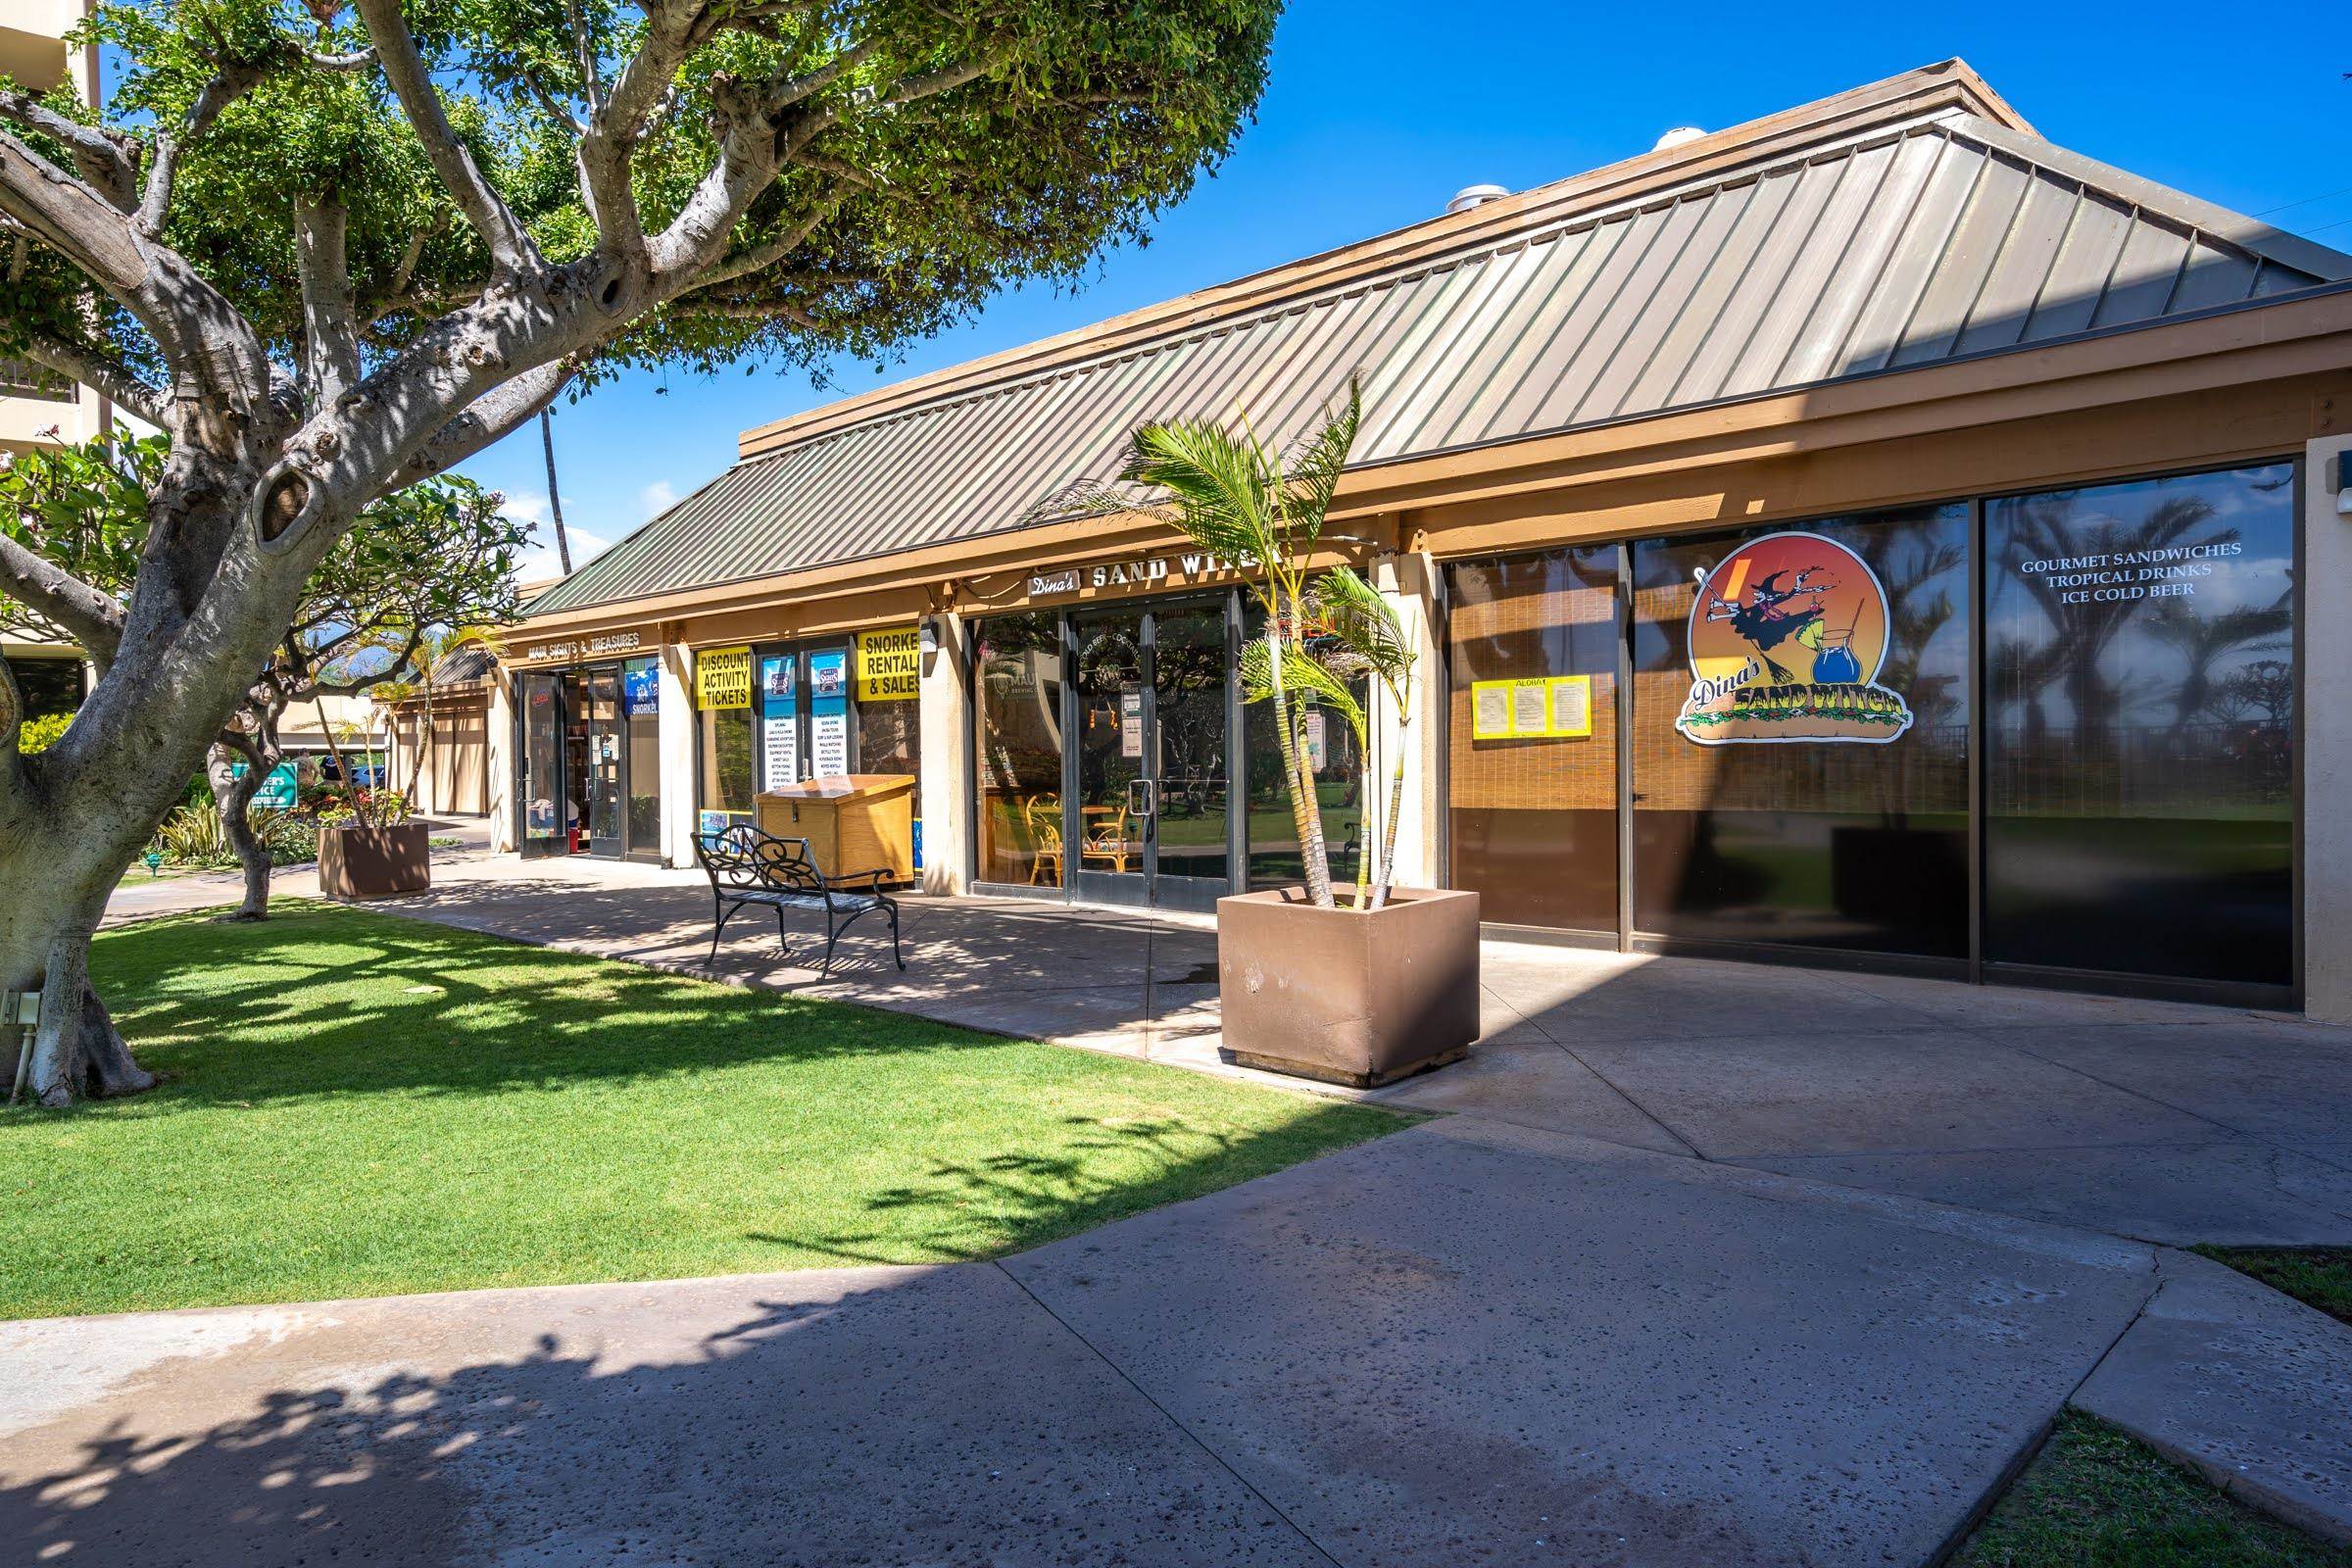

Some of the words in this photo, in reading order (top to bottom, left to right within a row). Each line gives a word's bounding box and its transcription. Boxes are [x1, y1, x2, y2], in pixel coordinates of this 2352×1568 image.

[2021, 555, 2110, 573] GOURMET
[2113, 542, 2242, 565] SANDWICHES
[1031, 572, 1073, 594] Dina's
[1093, 560, 1167, 587] SAND
[2046, 571, 2134, 588] TROPICAL
[2138, 564, 2212, 581] DRINKS
[2061, 591, 2089, 605] ICE
[2093, 587, 2145, 603] COLD
[2149, 583, 2195, 598] BEER
[549, 641, 578, 656] SIGHTS
[579, 640, 587, 653] &
[591, 632, 640, 651] TREASURES
[865, 632, 918, 655] SNORKE
[1079, 644, 1094, 664] COLD
[1092, 634, 1108, 646] BEER
[702, 652, 750, 671] DISCOUNT
[705, 670, 748, 688] ACTIVITY
[870, 677, 878, 695] &
[1692, 656, 1761, 711] Dina's
[706, 689, 747, 706] TICKETS
